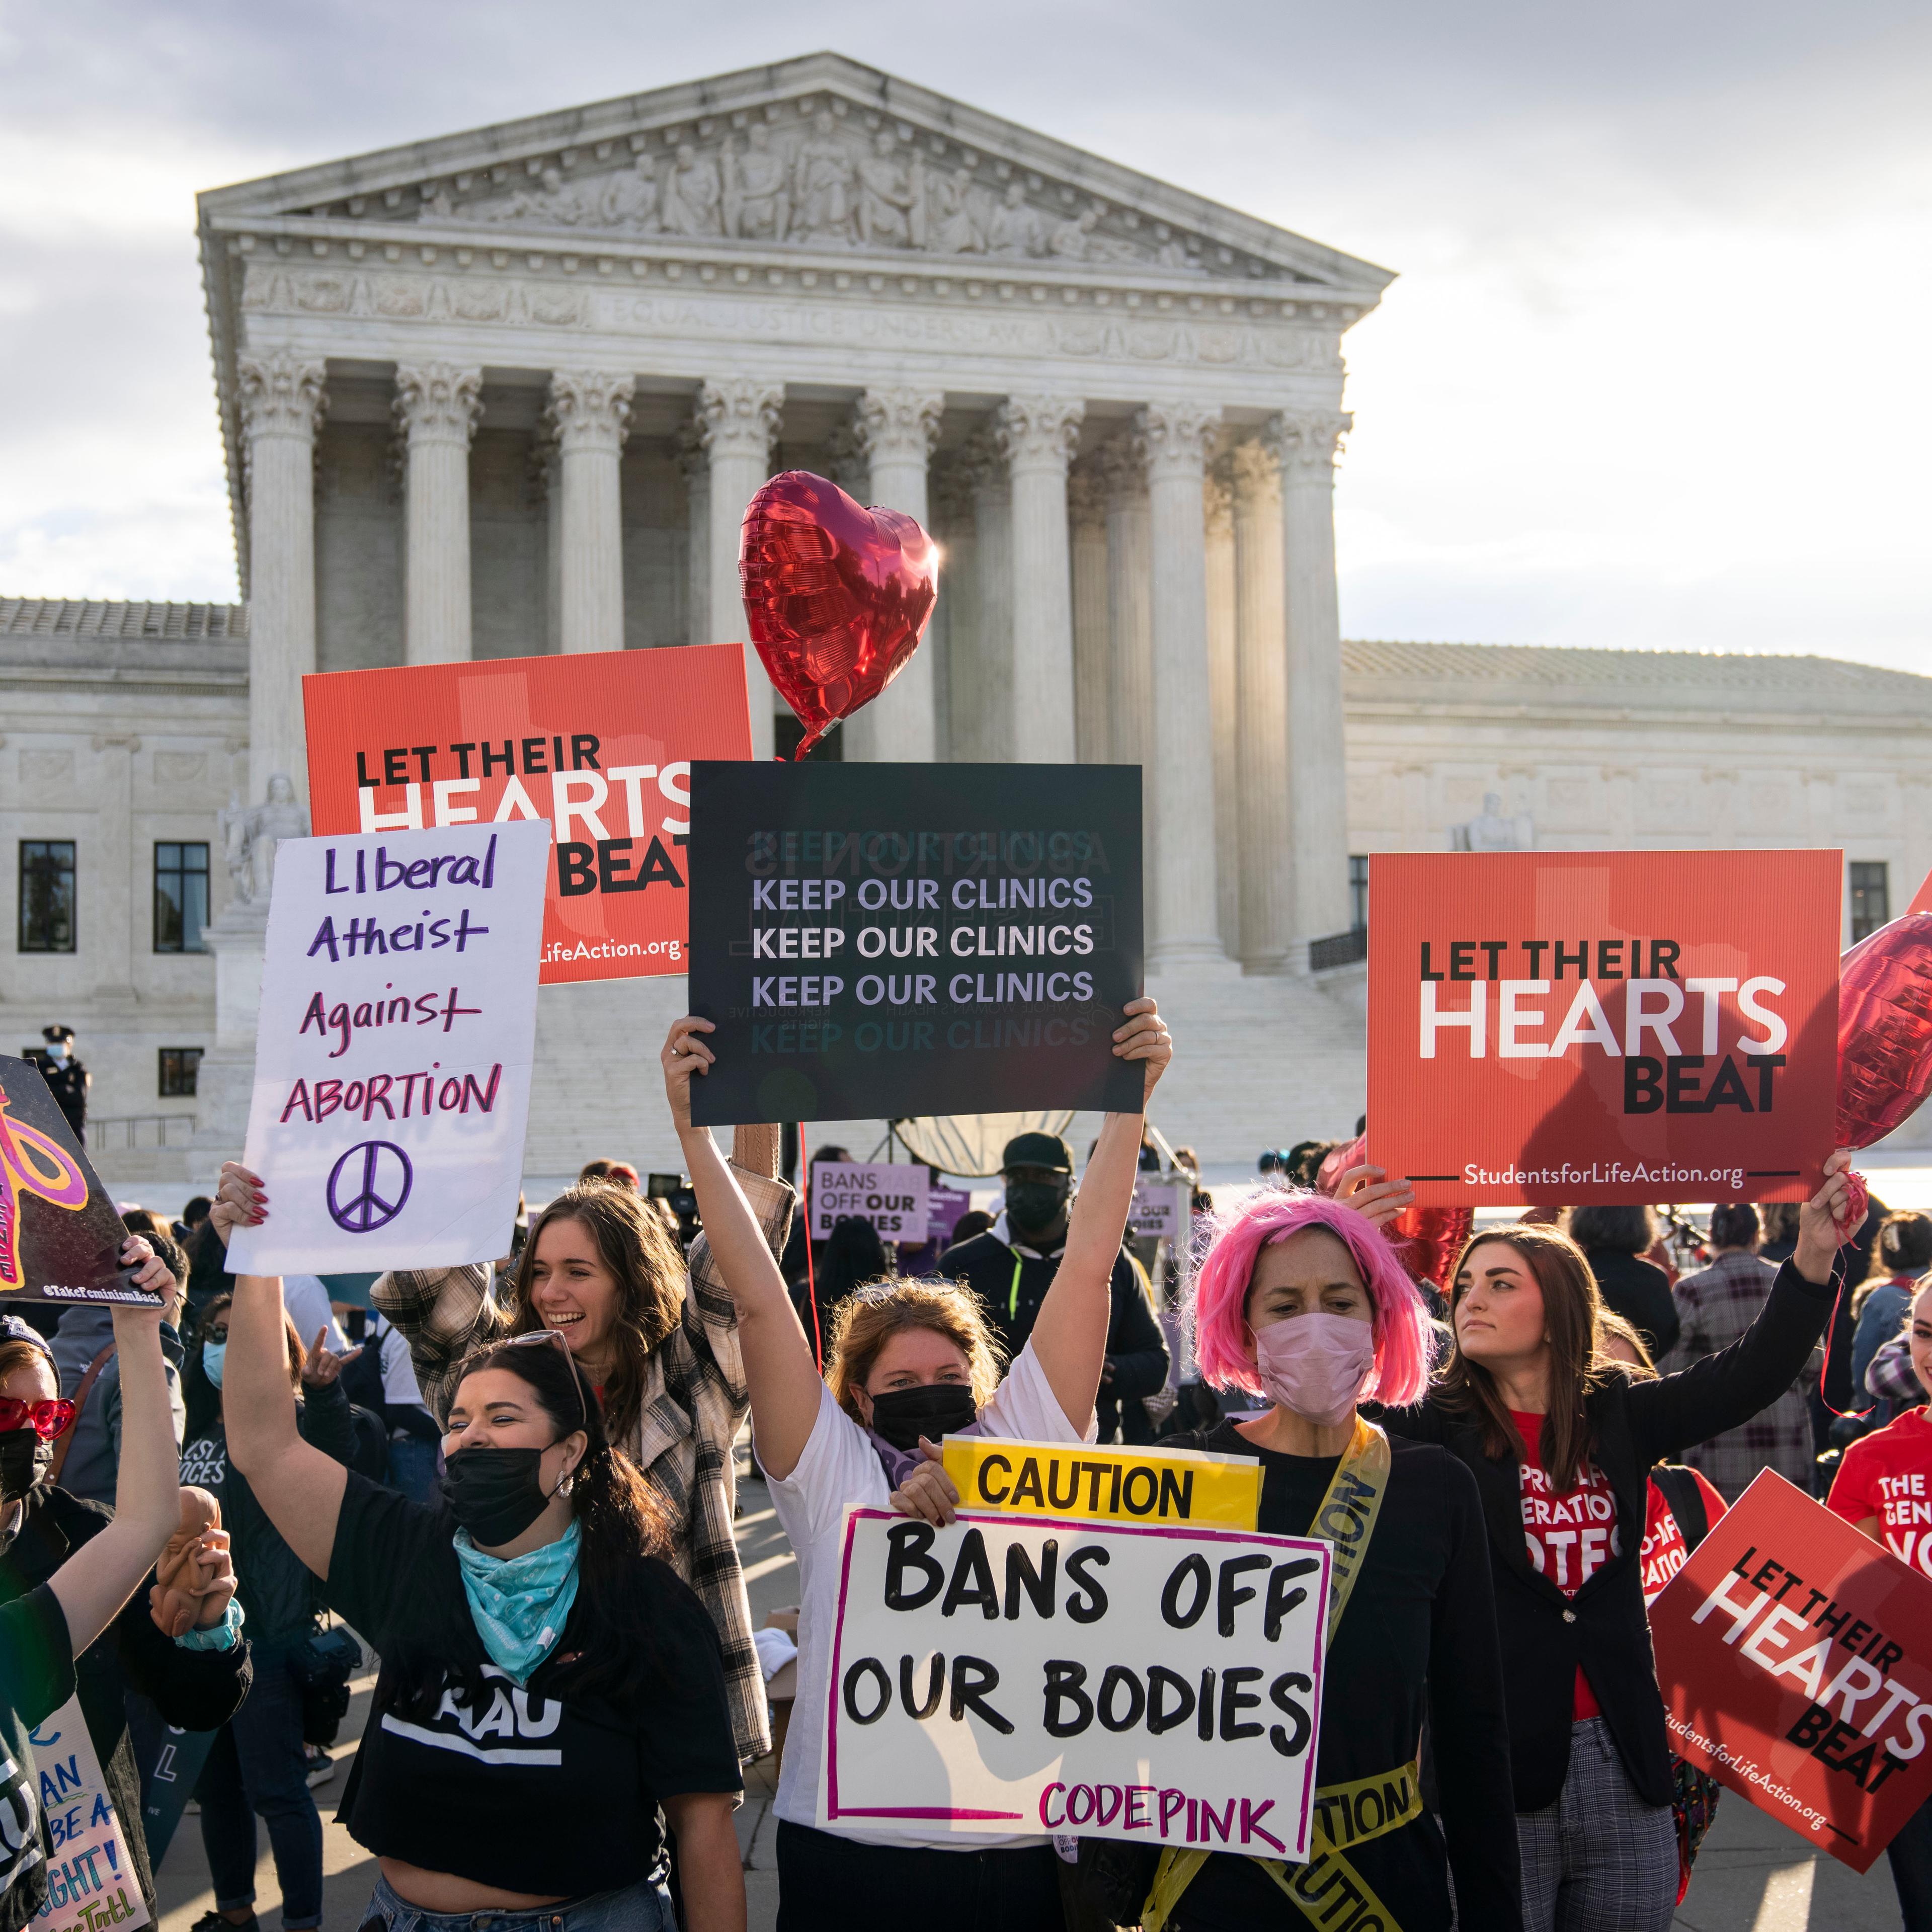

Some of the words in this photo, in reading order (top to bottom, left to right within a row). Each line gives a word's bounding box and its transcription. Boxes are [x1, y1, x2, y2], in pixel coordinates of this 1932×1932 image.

[612, 298, 718, 328] EQUAL
[723, 303, 846, 335] JUSTICE
[861, 312, 962, 342] UNDER
[971, 320, 1028, 346] LAW
[356, 746, 437, 786] LET
[451, 734, 601, 779] THEIR
[754, 879, 846, 910] KEEP
[857, 878, 940, 910] OUR
[951, 877, 1094, 909] CLINICS
[307, 909, 489, 962] Atheist
[753, 927, 845, 958] KEEP
[856, 926, 939, 957] OUR
[950, 924, 1094, 956] CLINICS
[1421, 941, 1507, 982] LET
[1521, 939, 1680, 980] THEIR
[753, 976, 845, 1007] KEEP
[855, 975, 937, 1005] OUR
[949, 971, 1094, 1003] CLINICS
[299, 982, 482, 1058] Against
[751, 1023, 843, 1054] KEEP
[854, 1021, 936, 1052] OUR
[946, 1019, 1091, 1051] CLINICS
[1420, 976, 1788, 1059] HEARTS
[1623, 1054, 1787, 1114] BEAT
[821, 1172, 877, 1190] BANS
[1464, 1161, 1744, 1188] StudentsforLifeAction.org
[821, 1192, 862, 1210] OFF
[865, 1193, 915, 1212] OUR
[43, 1285, 163, 1304] @TakeFeminismBack
[977, 1454, 1194, 1518] CAUTION
[1877, 1474, 1926, 1501] THE
[884, 1520, 1110, 1624] BANS
[1160, 1552, 1320, 1642] OFF
[1731, 1546, 1804, 1602] LET
[1799, 1588, 1904, 1674] THEIR
[1691, 1570, 1932, 1759] HEARTS
[842, 1652, 1015, 1735] OUR
[1043, 1658, 1313, 1757] BODIES
[1787, 1702, 1909, 1795] BEAT
[91, 1793, 115, 1828] A
[1038, 1781, 1286, 1854] CODEPINK
